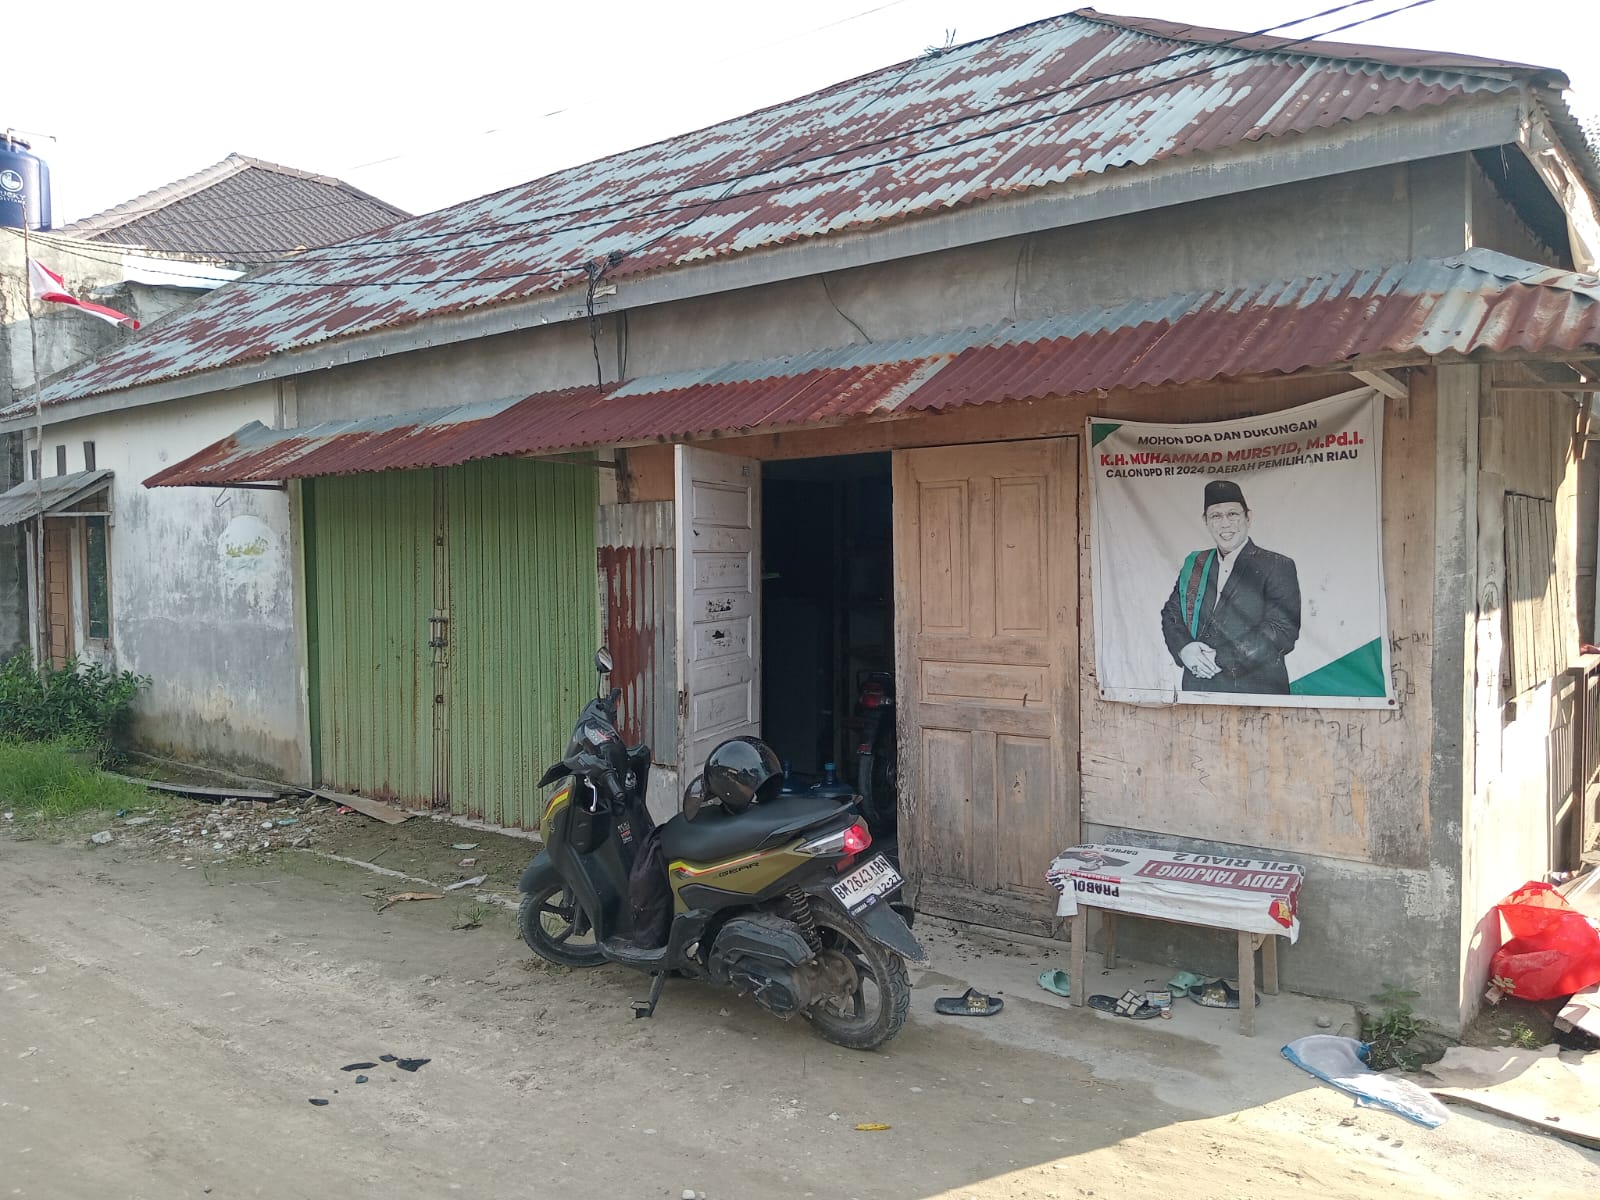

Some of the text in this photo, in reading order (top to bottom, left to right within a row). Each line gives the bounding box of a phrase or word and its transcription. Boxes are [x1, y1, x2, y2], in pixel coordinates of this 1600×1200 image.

[1137, 419, 1318, 446] MOHON DOA DAN DUKUNGAN
[1100, 431, 1364, 467] K.H. MUHAMMAD MURSYID, M.Pd.I.
[1105, 449, 1358, 478] CALON DPD RI 2024 DAERAH PEMILIHAN RIAU
[1172, 851, 1185, 861] 2
[1185, 854, 1245, 868] RIAU
[834, 882, 852, 900] BM
[847, 868, 873, 892] 2643
[1158, 864, 1239, 886] TANJUNG
[1238, 873, 1291, 890] EDDY
